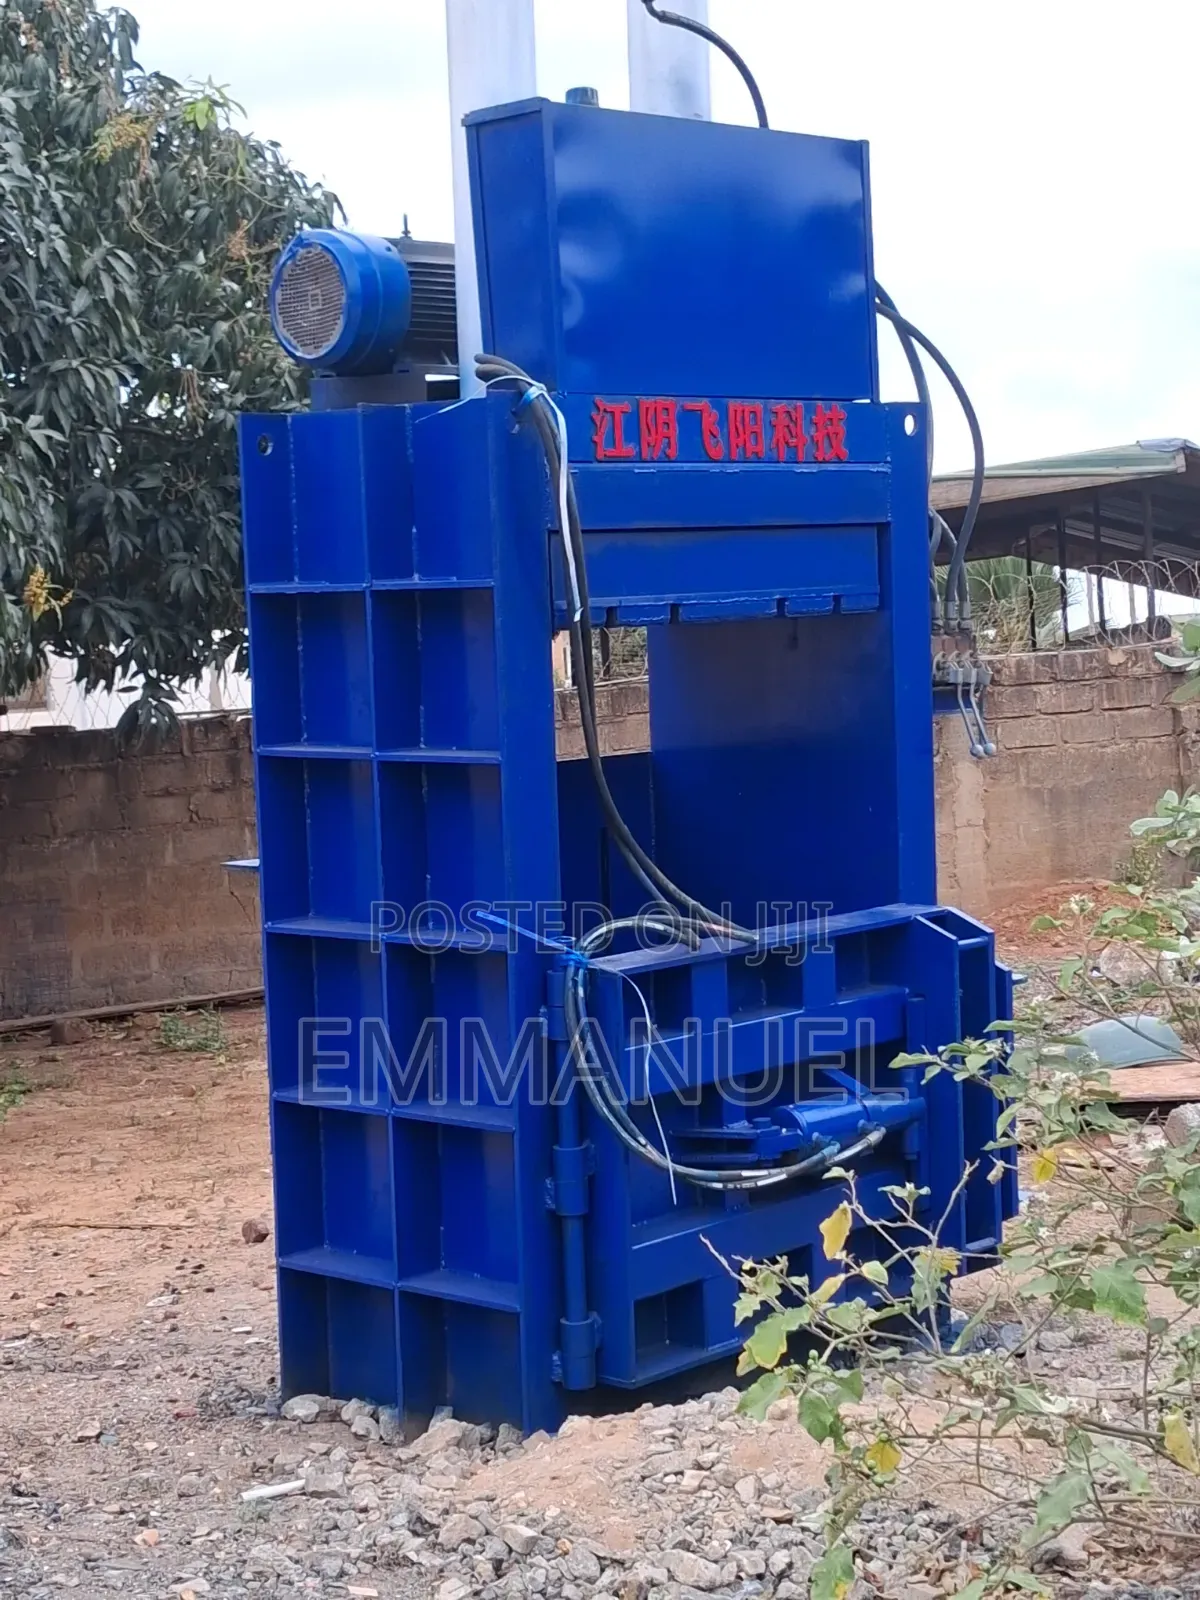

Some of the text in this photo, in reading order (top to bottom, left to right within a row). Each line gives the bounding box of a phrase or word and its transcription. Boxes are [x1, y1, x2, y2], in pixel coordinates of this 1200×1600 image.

[591, 397, 849, 462] 江阴飞阳科技
